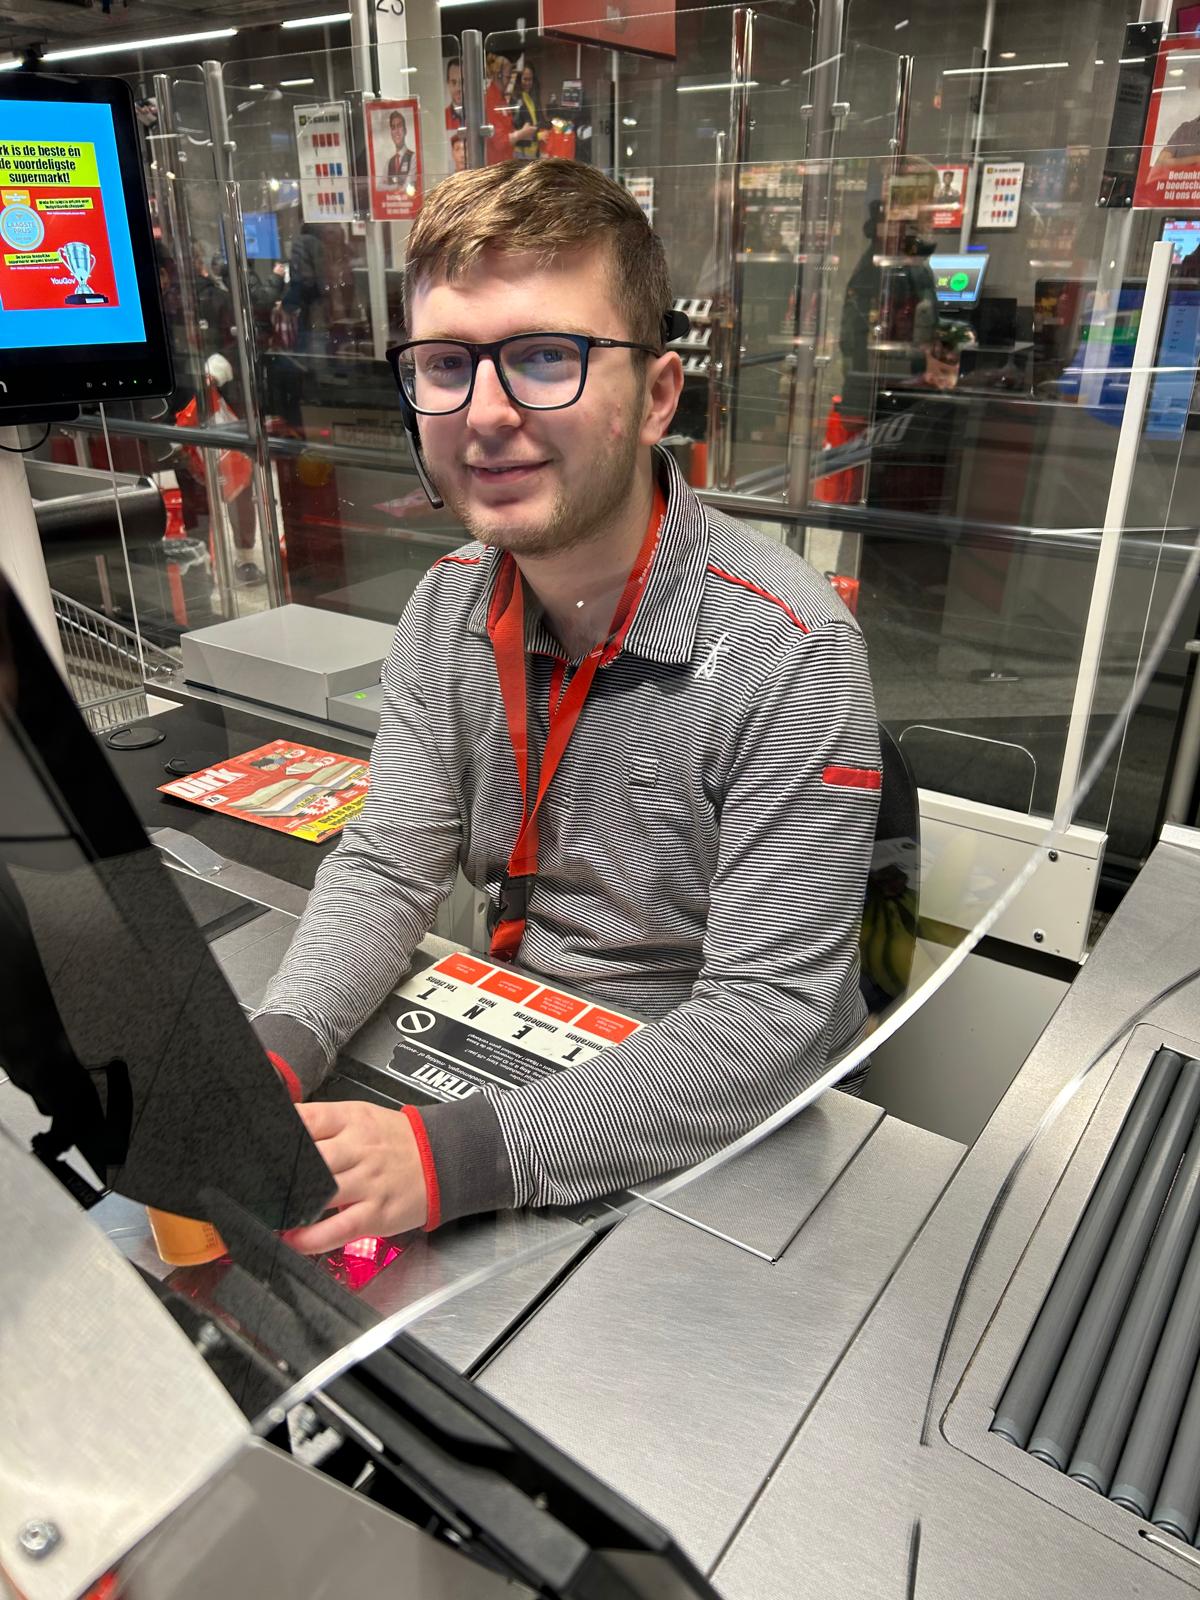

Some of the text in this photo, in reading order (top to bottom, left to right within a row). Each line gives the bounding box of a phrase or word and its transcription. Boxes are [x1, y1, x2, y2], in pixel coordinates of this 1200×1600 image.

[11, 145, 21, 156] is
[23, 145, 36, 156] de
[38, 145, 66, 157] beste
[68, 145, 81, 157] én
[13, 158, 76, 171] voordeligste
[9, 172, 70, 184] supermarkt!
[50, 277, 76, 285] YouGov
[164, 768, 248, 799] Dirk
[425, 975, 458, 993] Tot ziens
[416, 987, 437, 1000] T
[478, 997, 498, 1008] Nota
[462, 1005, 486, 1020] N
[513, 1011, 559, 1033] Eindbedrag
[512, 1025, 533, 1040] E
[561, 1046, 582, 1062] T
